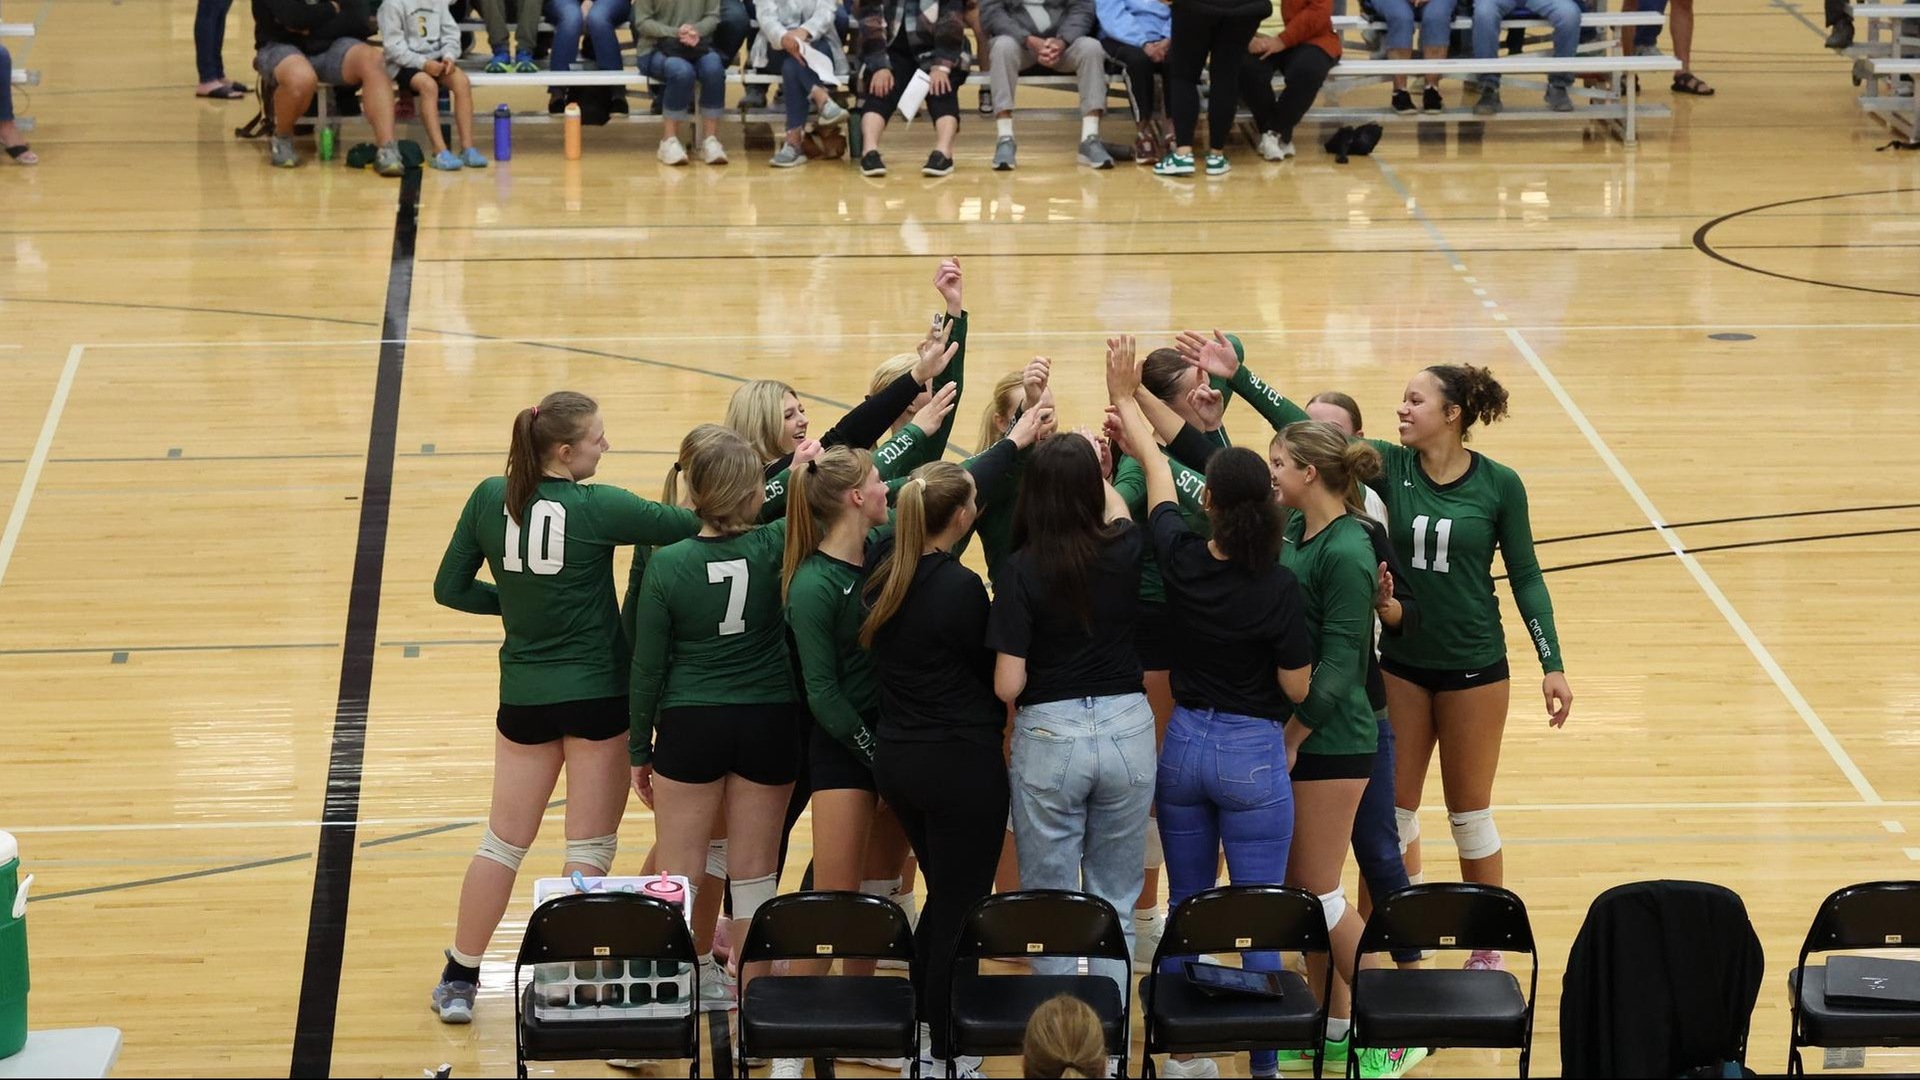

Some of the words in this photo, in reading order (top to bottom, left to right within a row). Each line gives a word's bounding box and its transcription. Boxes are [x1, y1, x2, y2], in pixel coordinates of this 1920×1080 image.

[877, 434, 914, 465] SCTCC
[502, 498, 567, 576] 10
[1411, 514, 1453, 573] 11
[706, 558, 750, 636] 7
